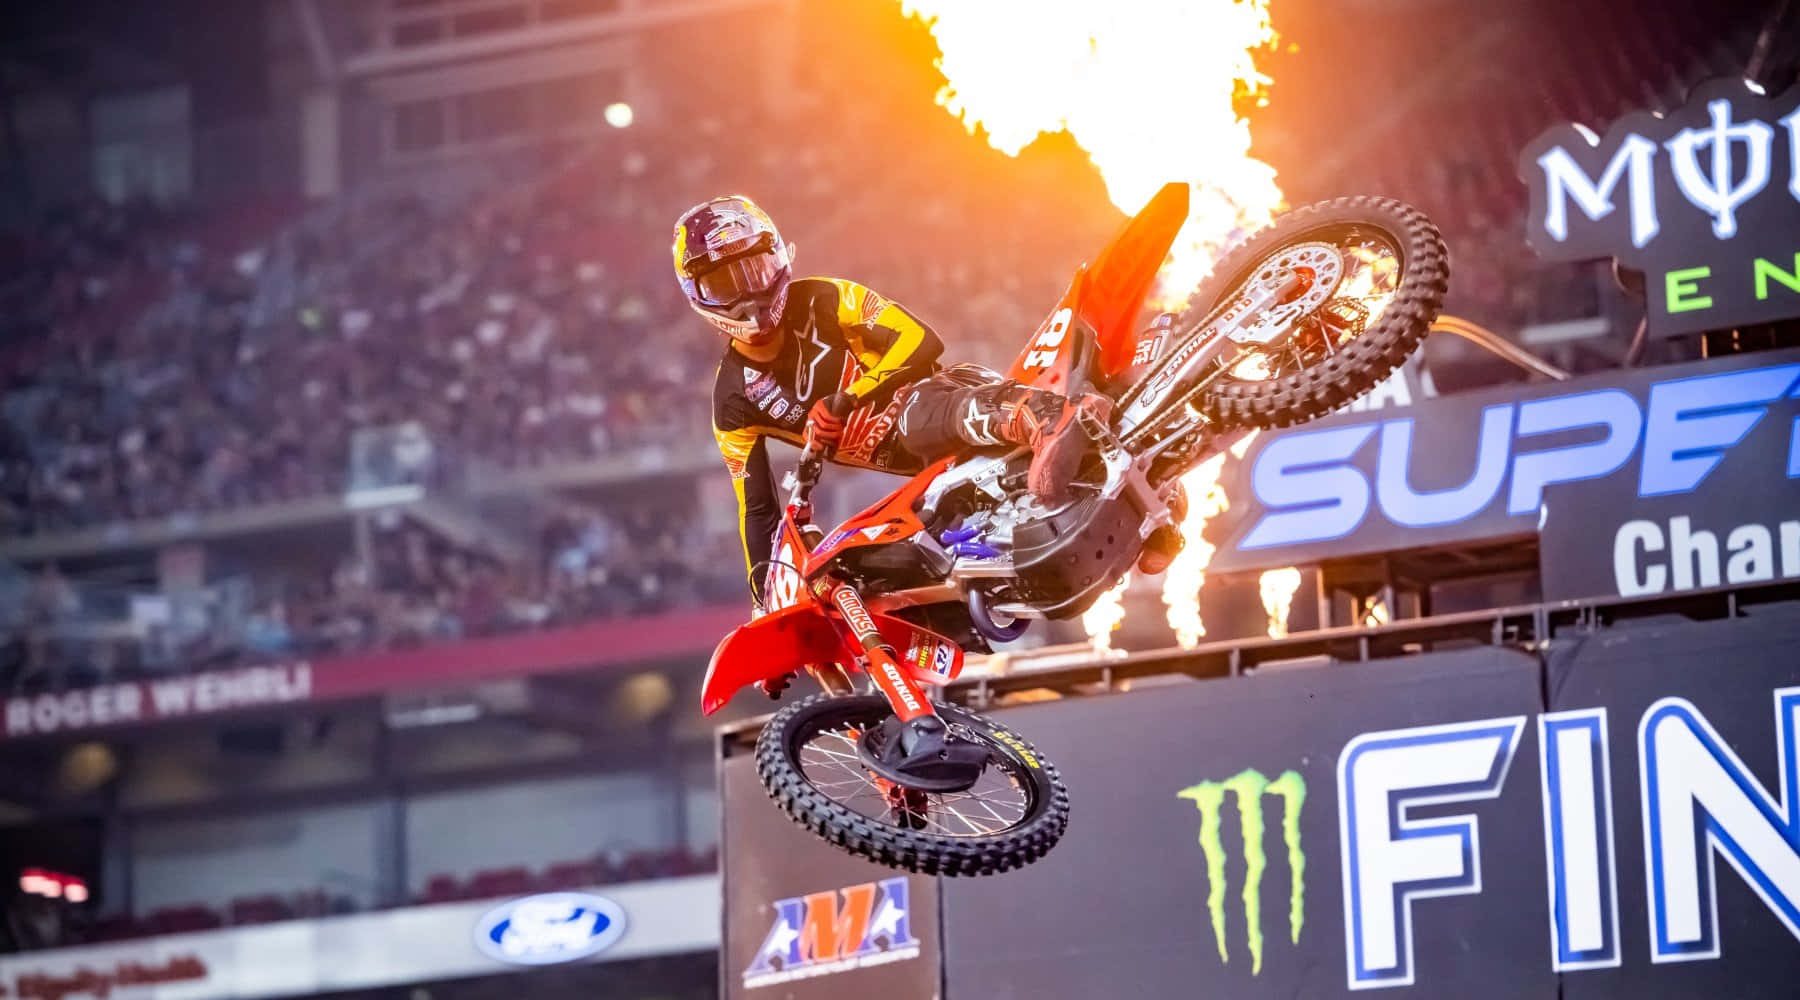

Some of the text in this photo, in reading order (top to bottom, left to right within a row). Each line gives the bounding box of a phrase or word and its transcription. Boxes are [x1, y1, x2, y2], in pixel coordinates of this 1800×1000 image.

[1537, 98, 1800, 248] MO
[1023, 308, 1073, 370] 18
[758, 384, 782, 411] SHOWA
[1237, 363, 1800, 551] SUPE
[838, 591, 875, 632] SHOWA
[5, 660, 311, 736] ROGER WEHRLI
[881, 662, 921, 711] DUNLOP
[993, 731, 1040, 769] DUNLOP
[742, 876, 921, 978] AMA
